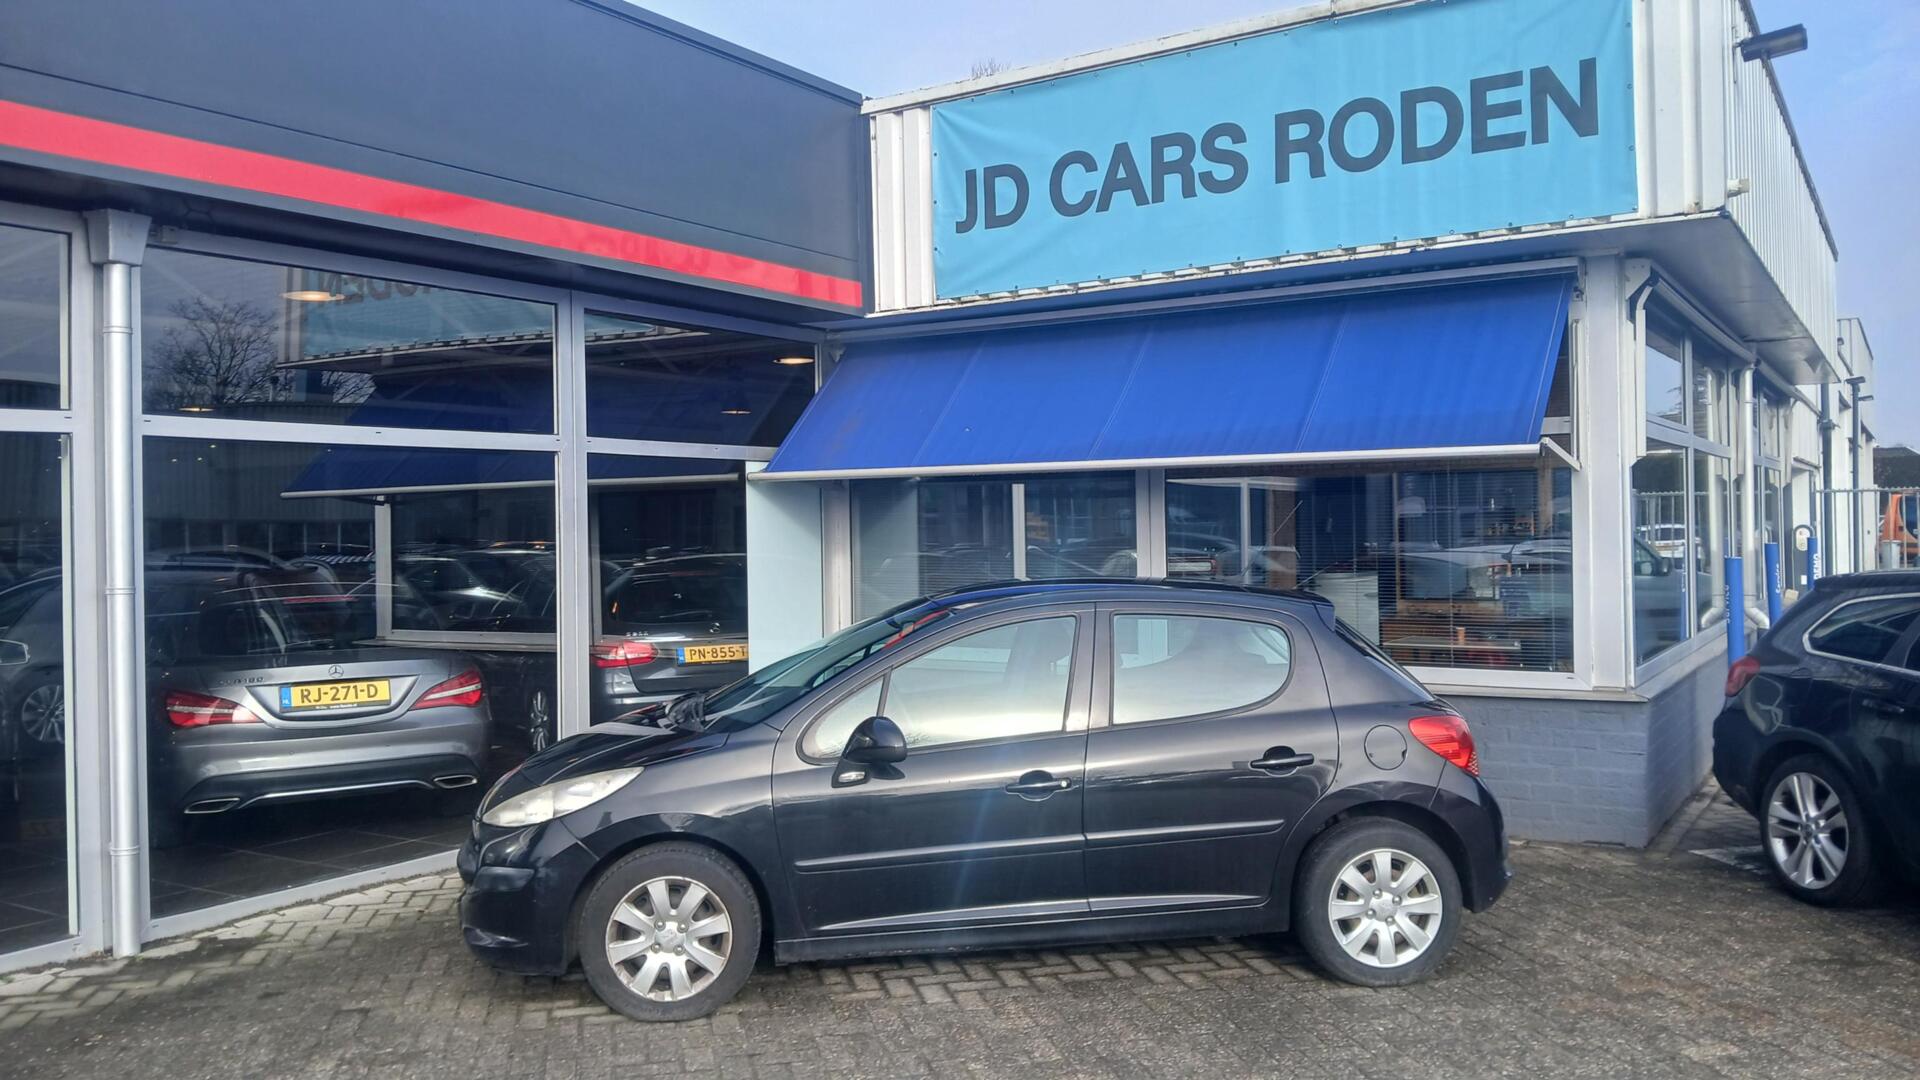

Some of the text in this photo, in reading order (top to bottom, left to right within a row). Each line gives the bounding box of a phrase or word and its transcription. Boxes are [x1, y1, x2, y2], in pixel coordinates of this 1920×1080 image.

[956, 58, 1598, 233] JD CARS RODEN
[689, 646, 747, 660] PN-855-T
[300, 684, 378, 704] RJ-271-D
